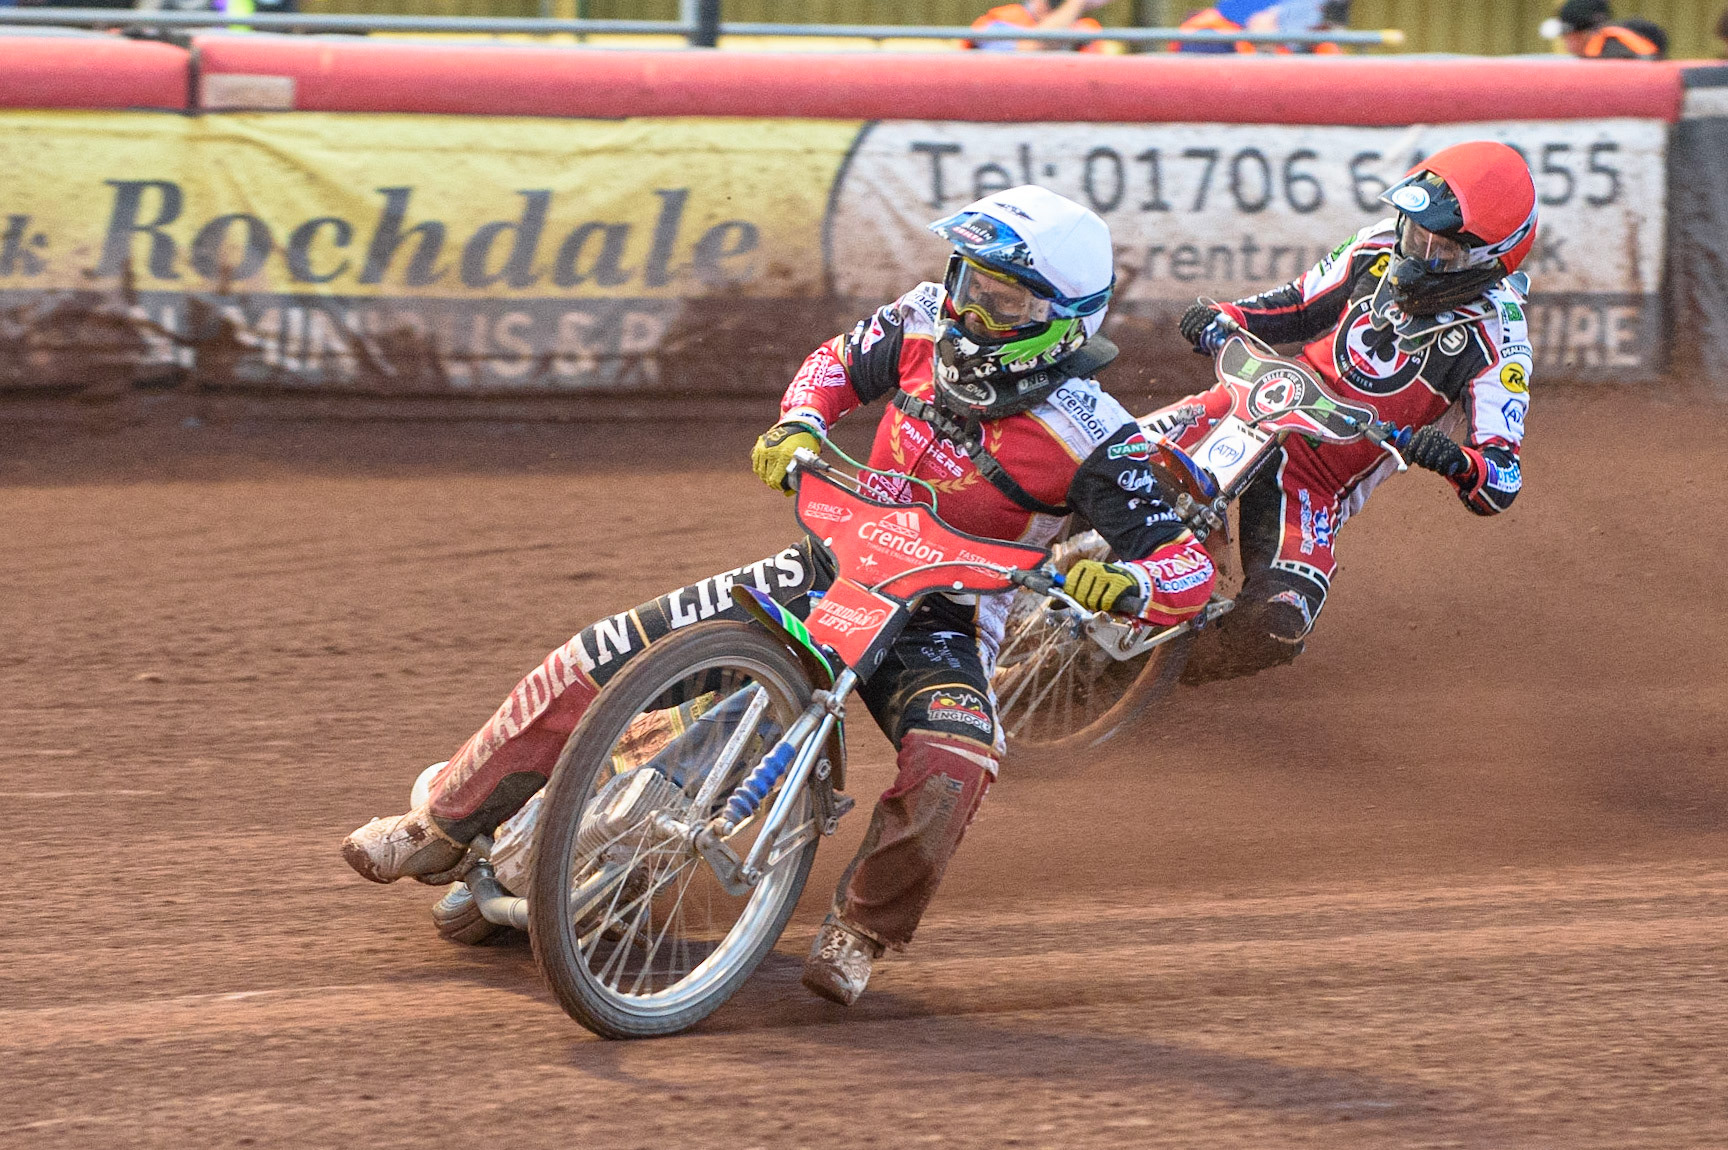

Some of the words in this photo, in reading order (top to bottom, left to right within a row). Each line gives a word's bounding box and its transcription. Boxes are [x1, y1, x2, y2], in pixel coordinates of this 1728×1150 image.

[1083, 145, 1328, 214] 01706
[98, 179, 760, 288] Rochdale
[1056, 388, 1105, 440] Crendon
[900, 420, 964, 478] PANTHERS
[807, 501, 845, 516] FASTRACK
[858, 521, 944, 564] Crendon
[668, 547, 804, 630] LIFTS
[818, 613, 852, 633] LIFTS
